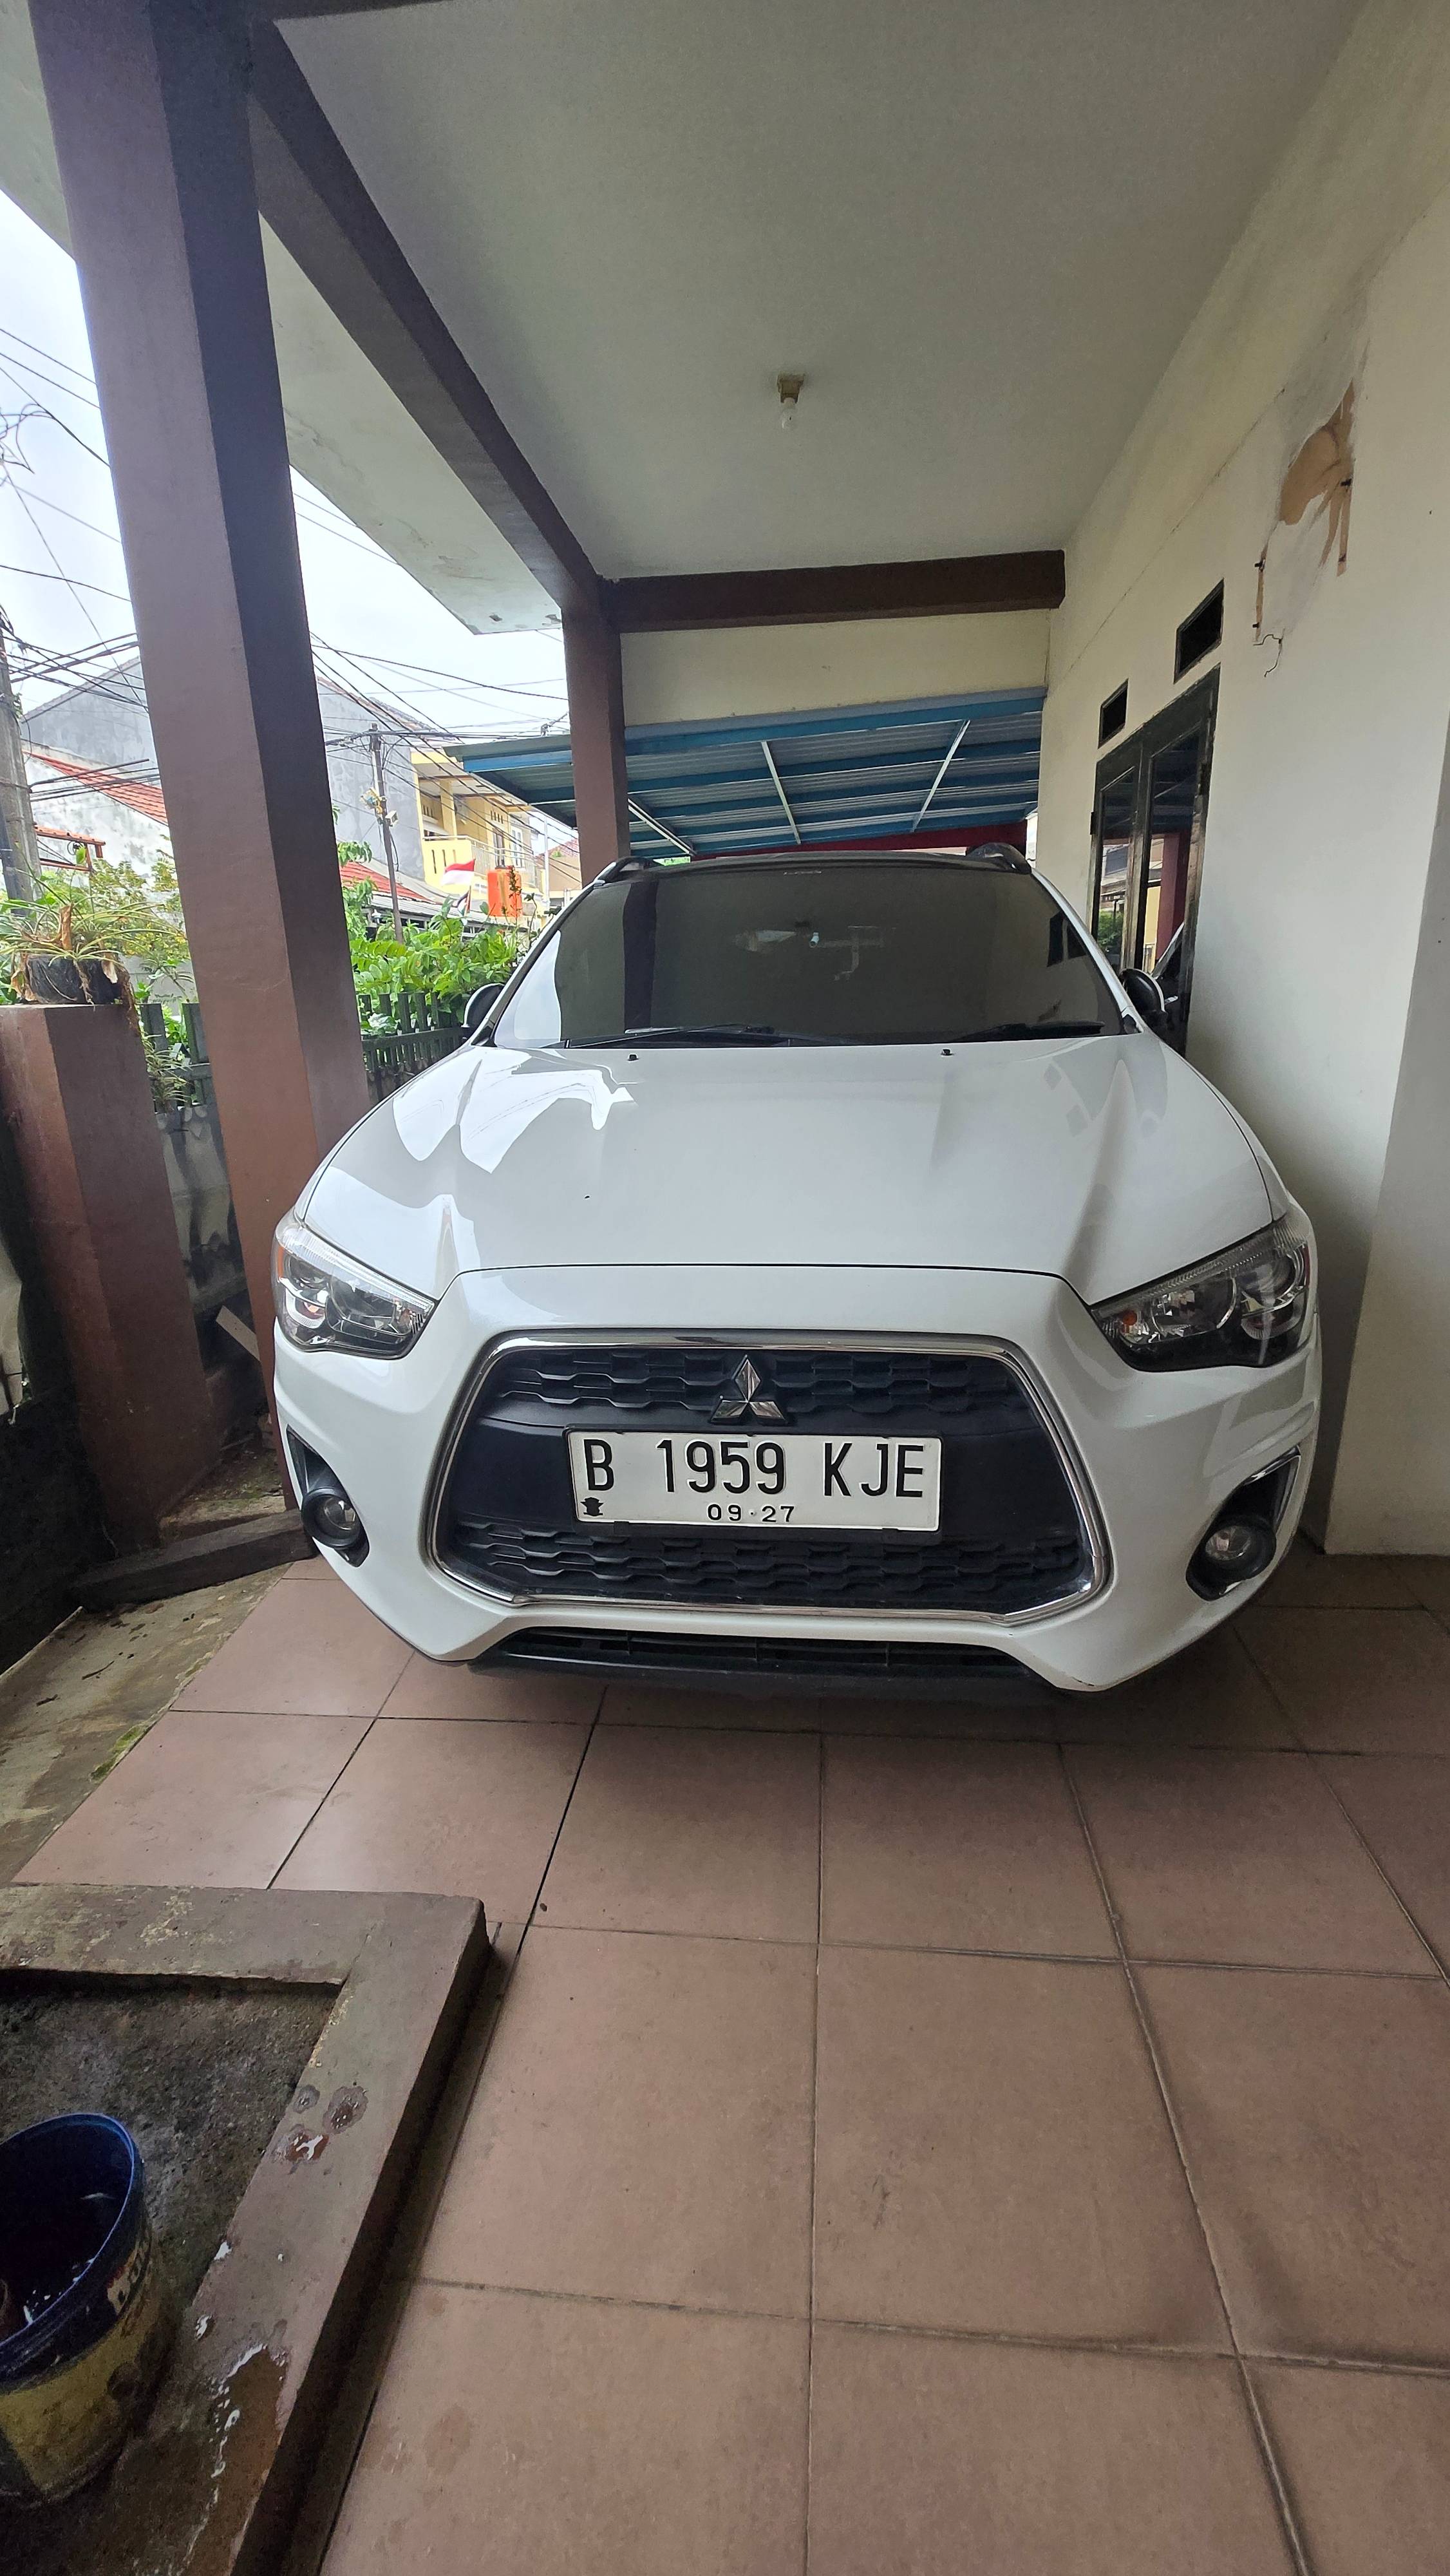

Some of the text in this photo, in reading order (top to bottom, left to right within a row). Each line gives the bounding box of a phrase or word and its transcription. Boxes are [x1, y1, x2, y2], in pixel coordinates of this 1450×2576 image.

[583, 1439, 925, 1498] B 1959 KJE
